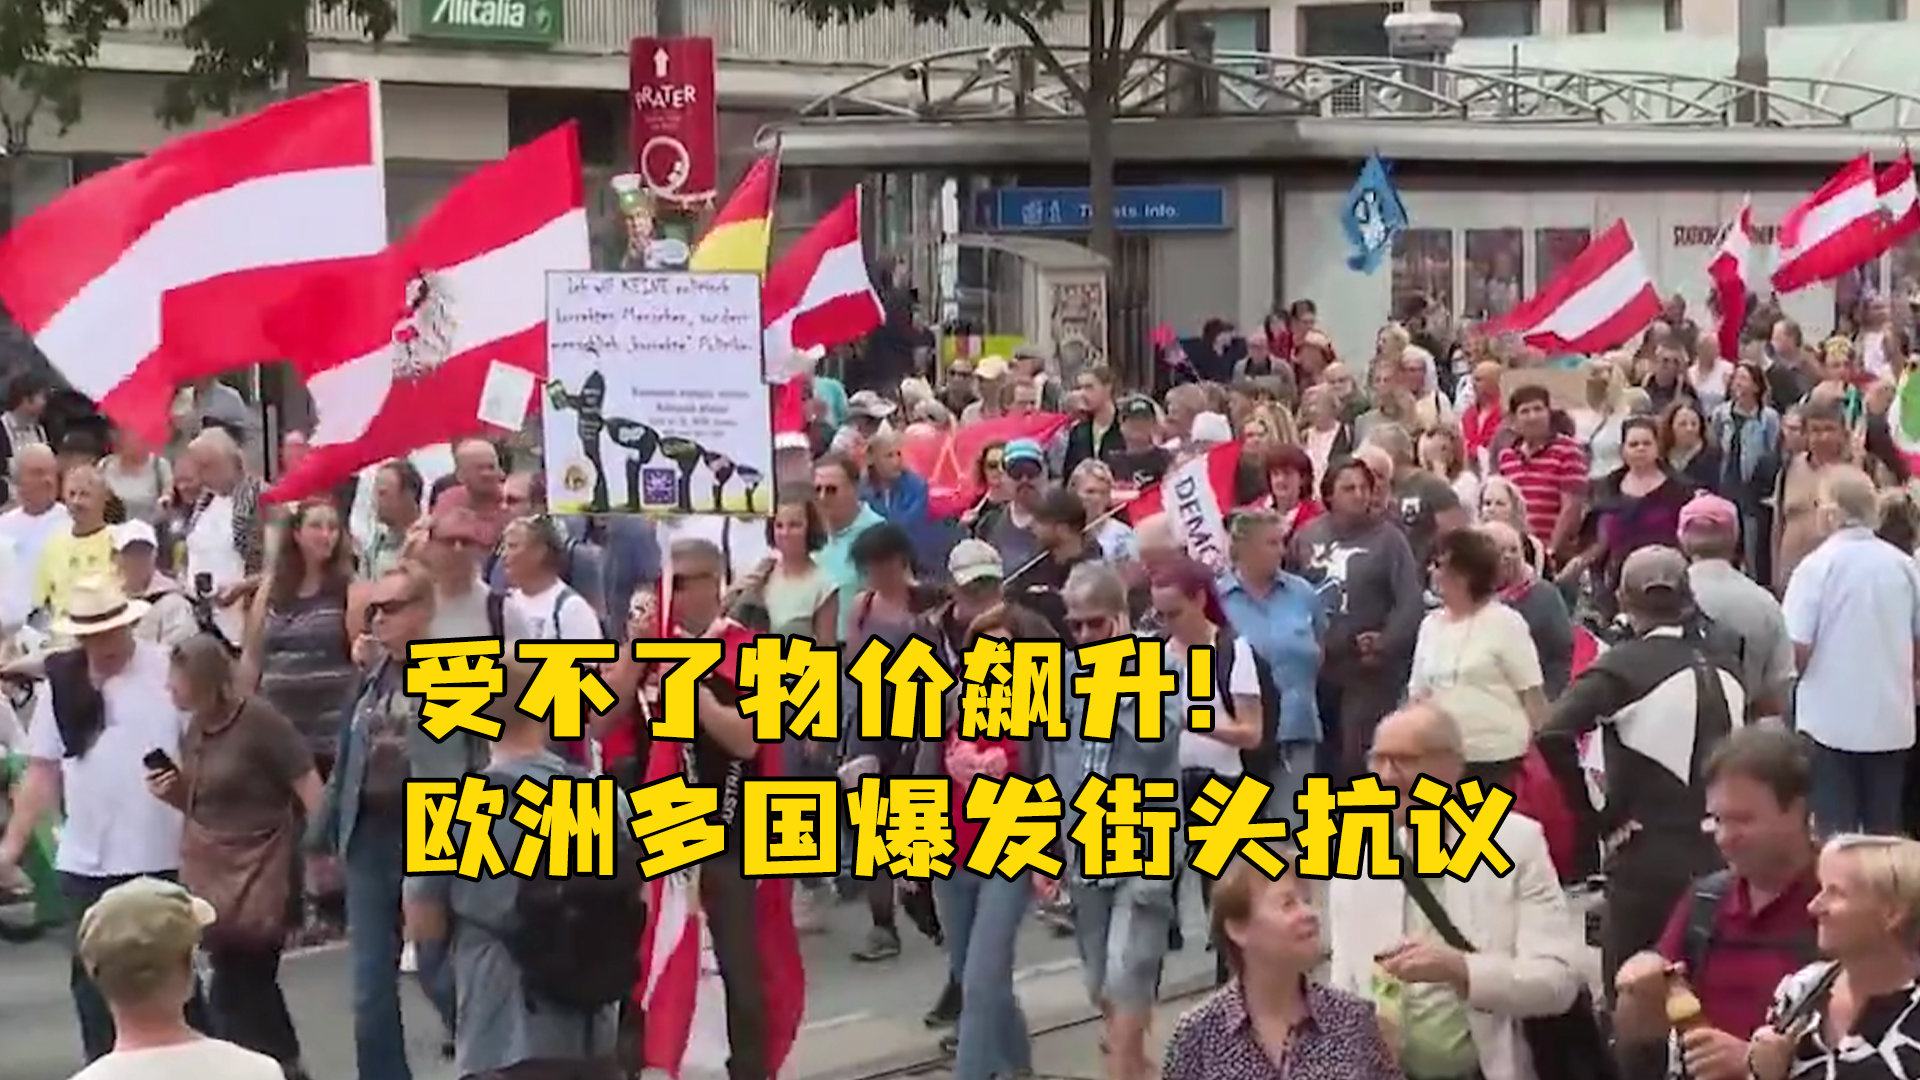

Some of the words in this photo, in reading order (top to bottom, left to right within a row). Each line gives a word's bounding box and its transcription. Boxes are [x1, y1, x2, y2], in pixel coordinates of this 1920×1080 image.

[432, 0, 525, 27] Alitalia
[635, 84, 696, 111] PRATER
[621, 277, 670, 296] KEINE
